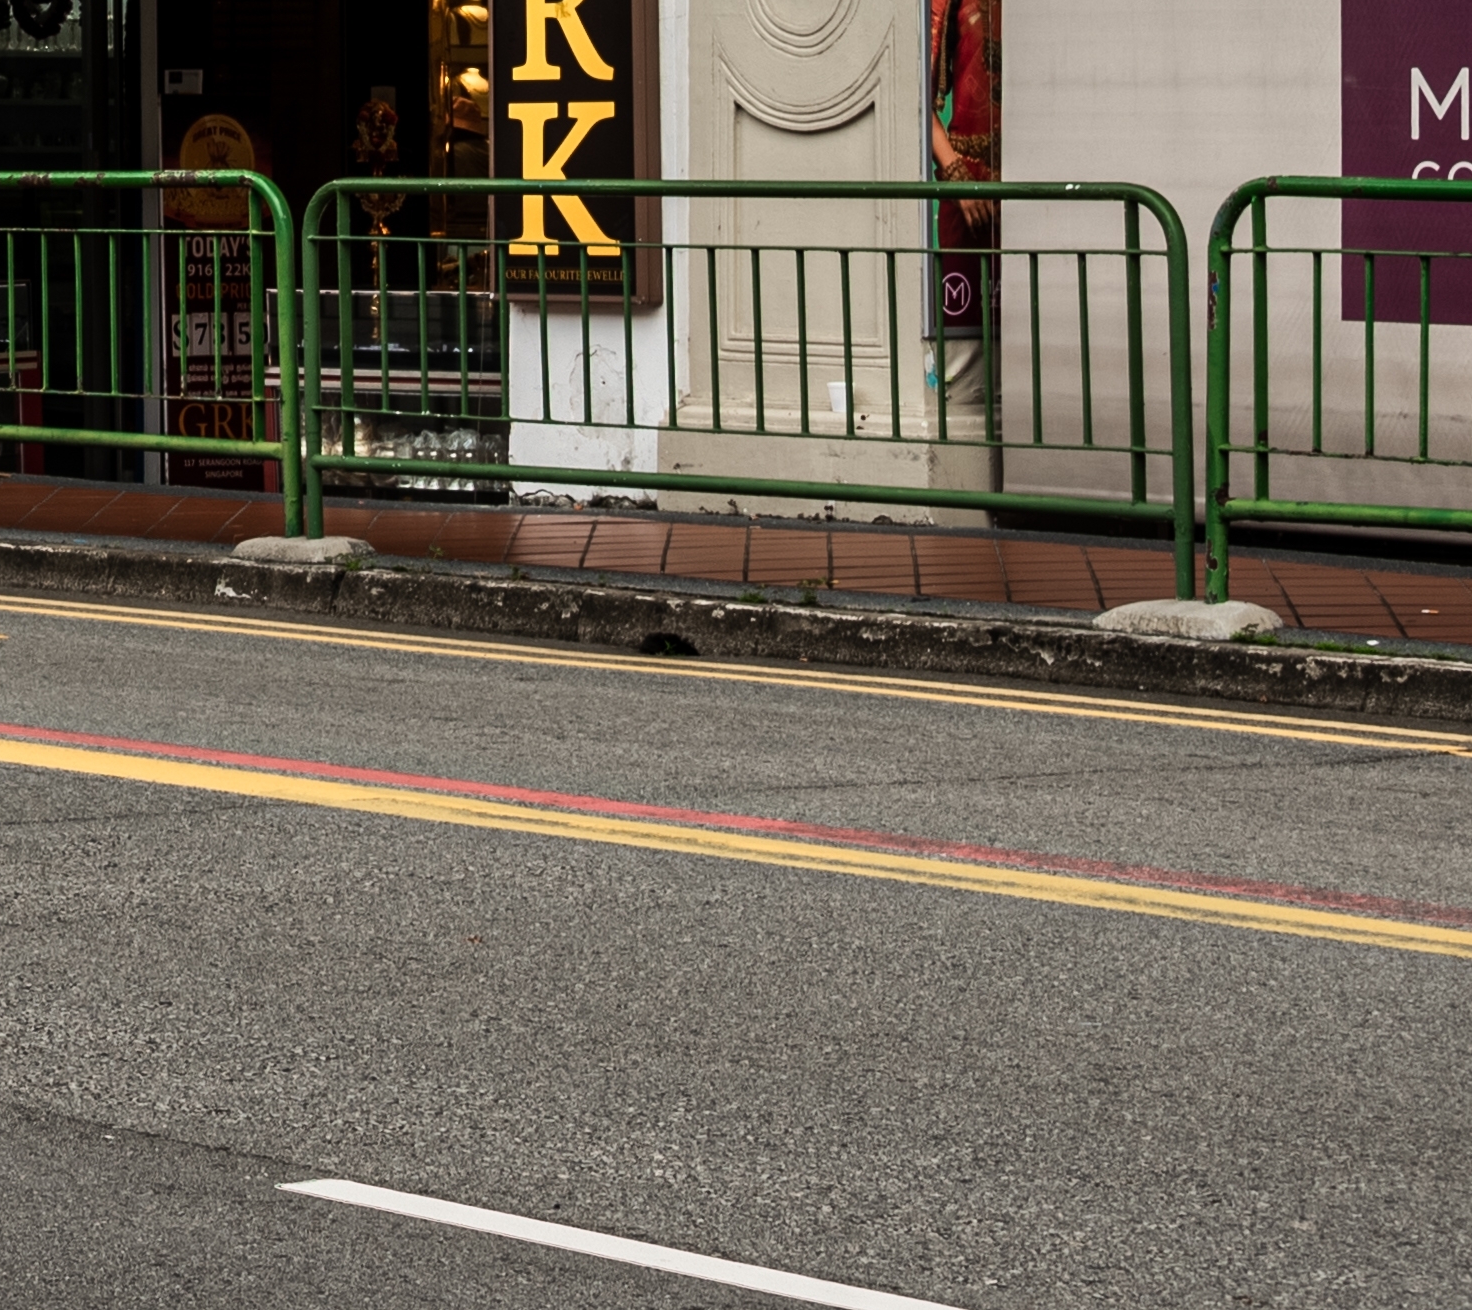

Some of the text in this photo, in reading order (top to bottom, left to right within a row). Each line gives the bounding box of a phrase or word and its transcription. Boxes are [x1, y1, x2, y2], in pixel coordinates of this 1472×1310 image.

[504, 269, 581, 281] OUR FAOURITE
[198, 457, 241, 467] SERANGOON
[204, 469, 244, 479] SINGAPORE
